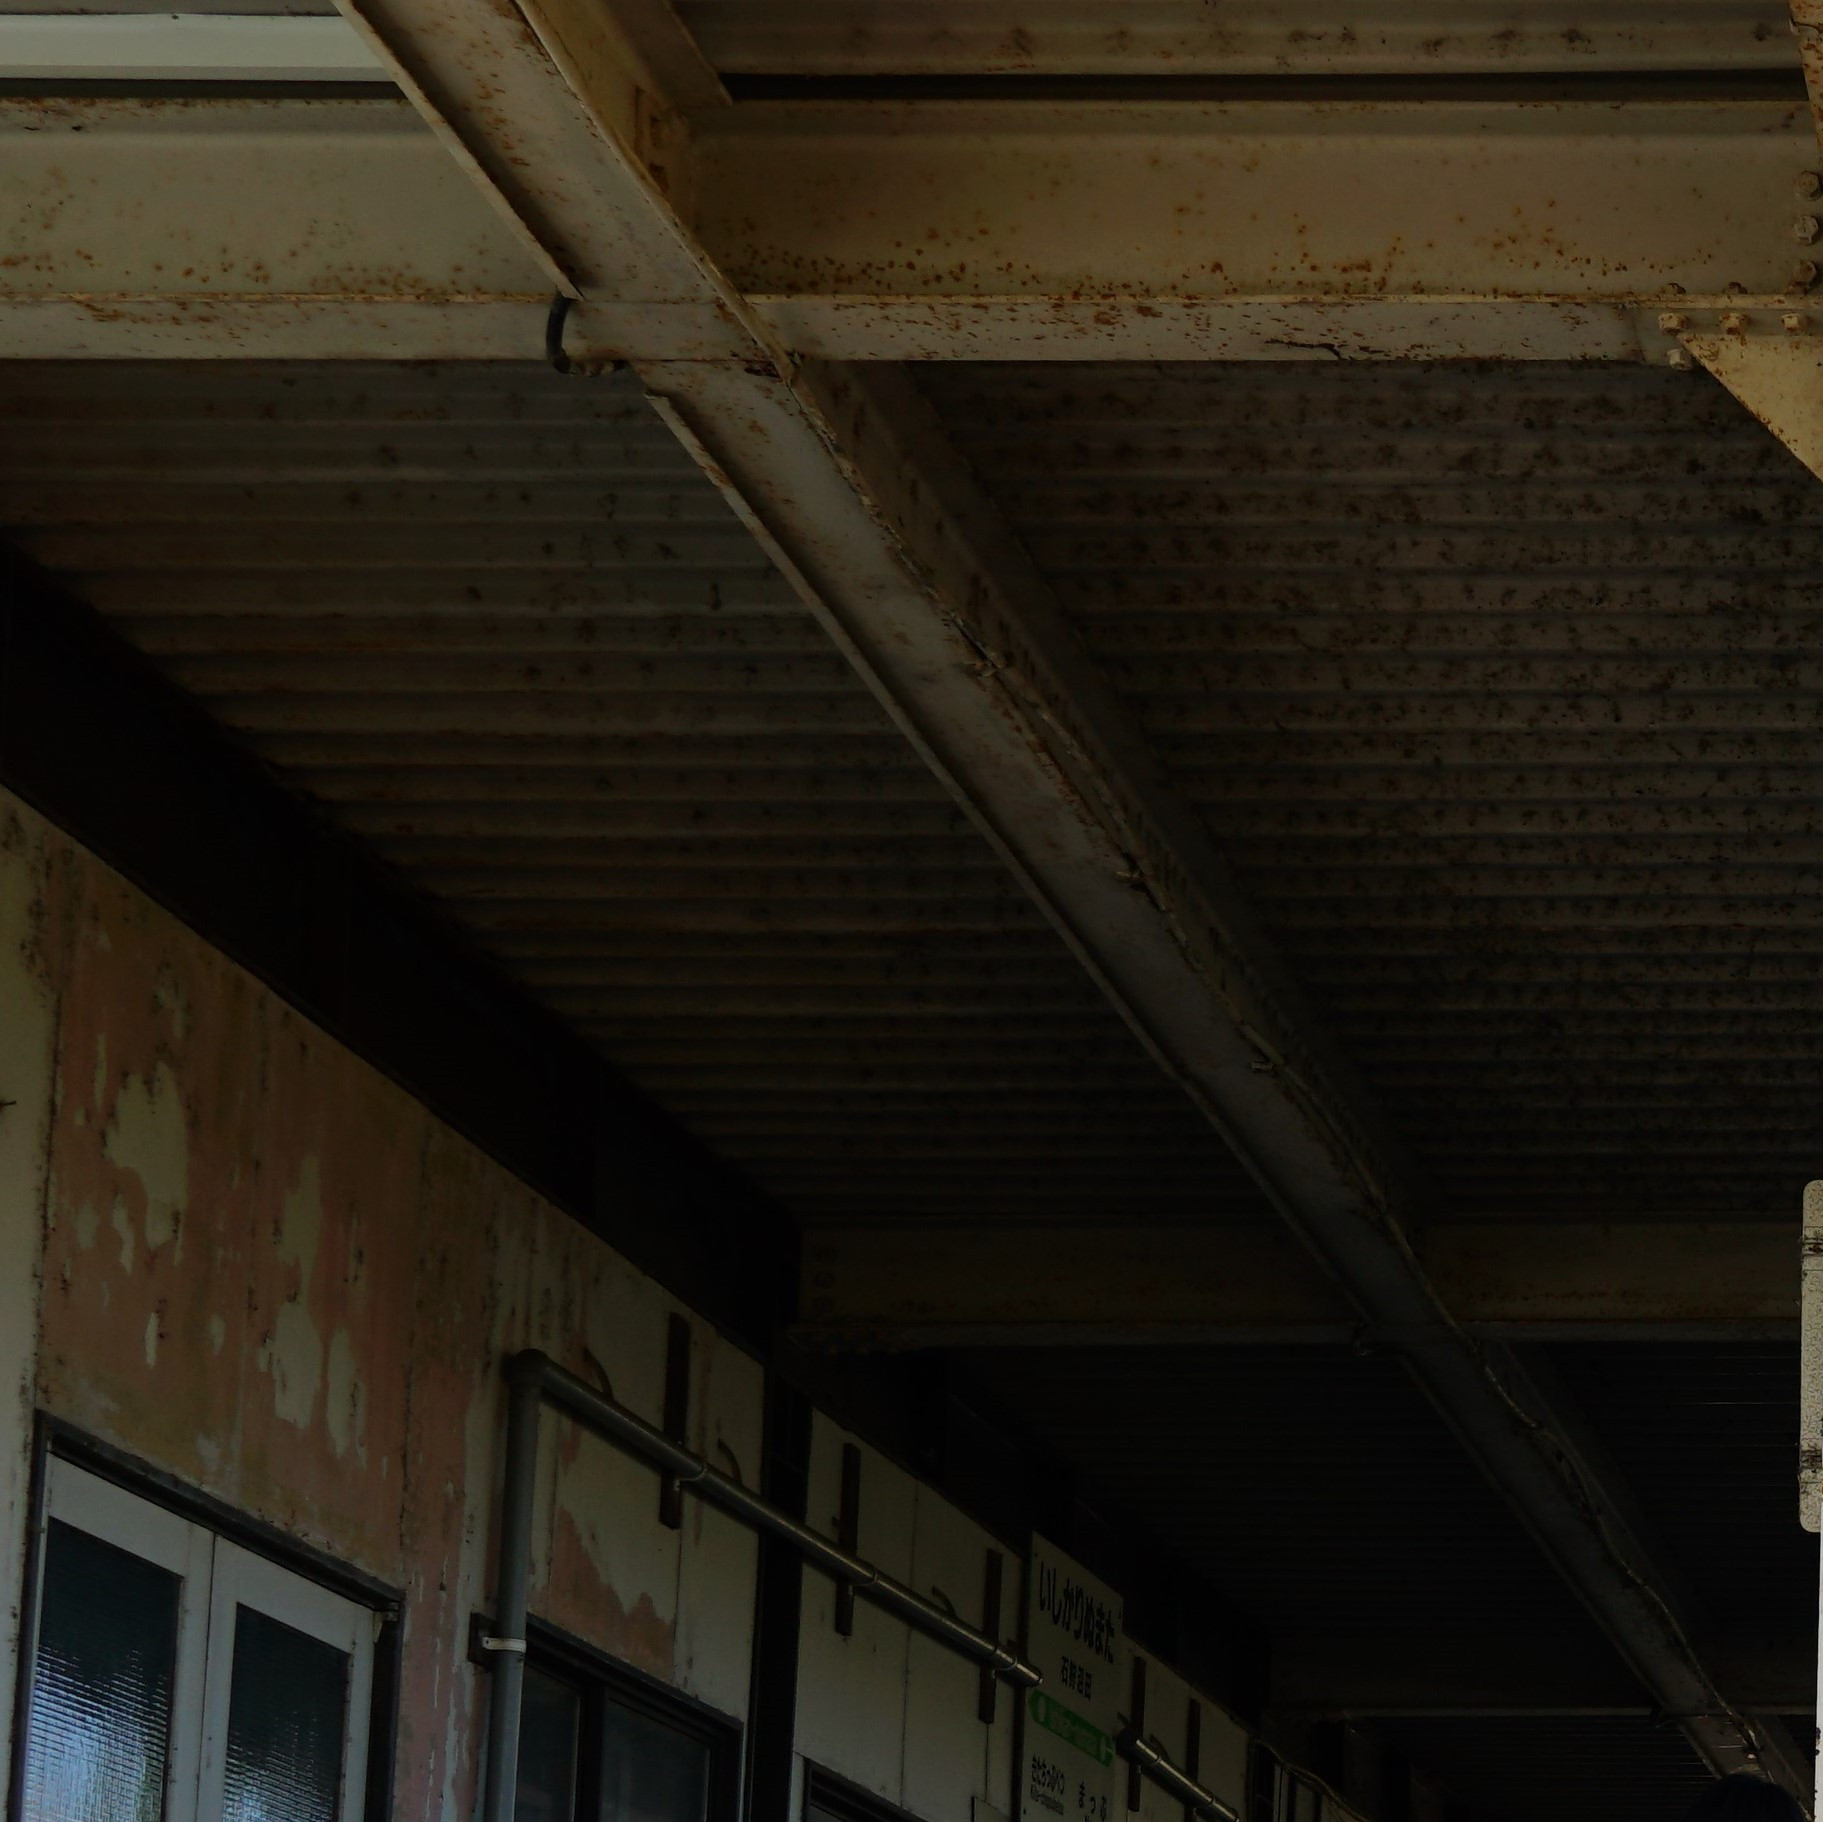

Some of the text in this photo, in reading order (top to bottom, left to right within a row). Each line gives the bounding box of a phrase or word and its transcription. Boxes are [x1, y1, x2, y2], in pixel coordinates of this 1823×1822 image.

[1038, 1560, 1115, 1664] いしかりぬまた
